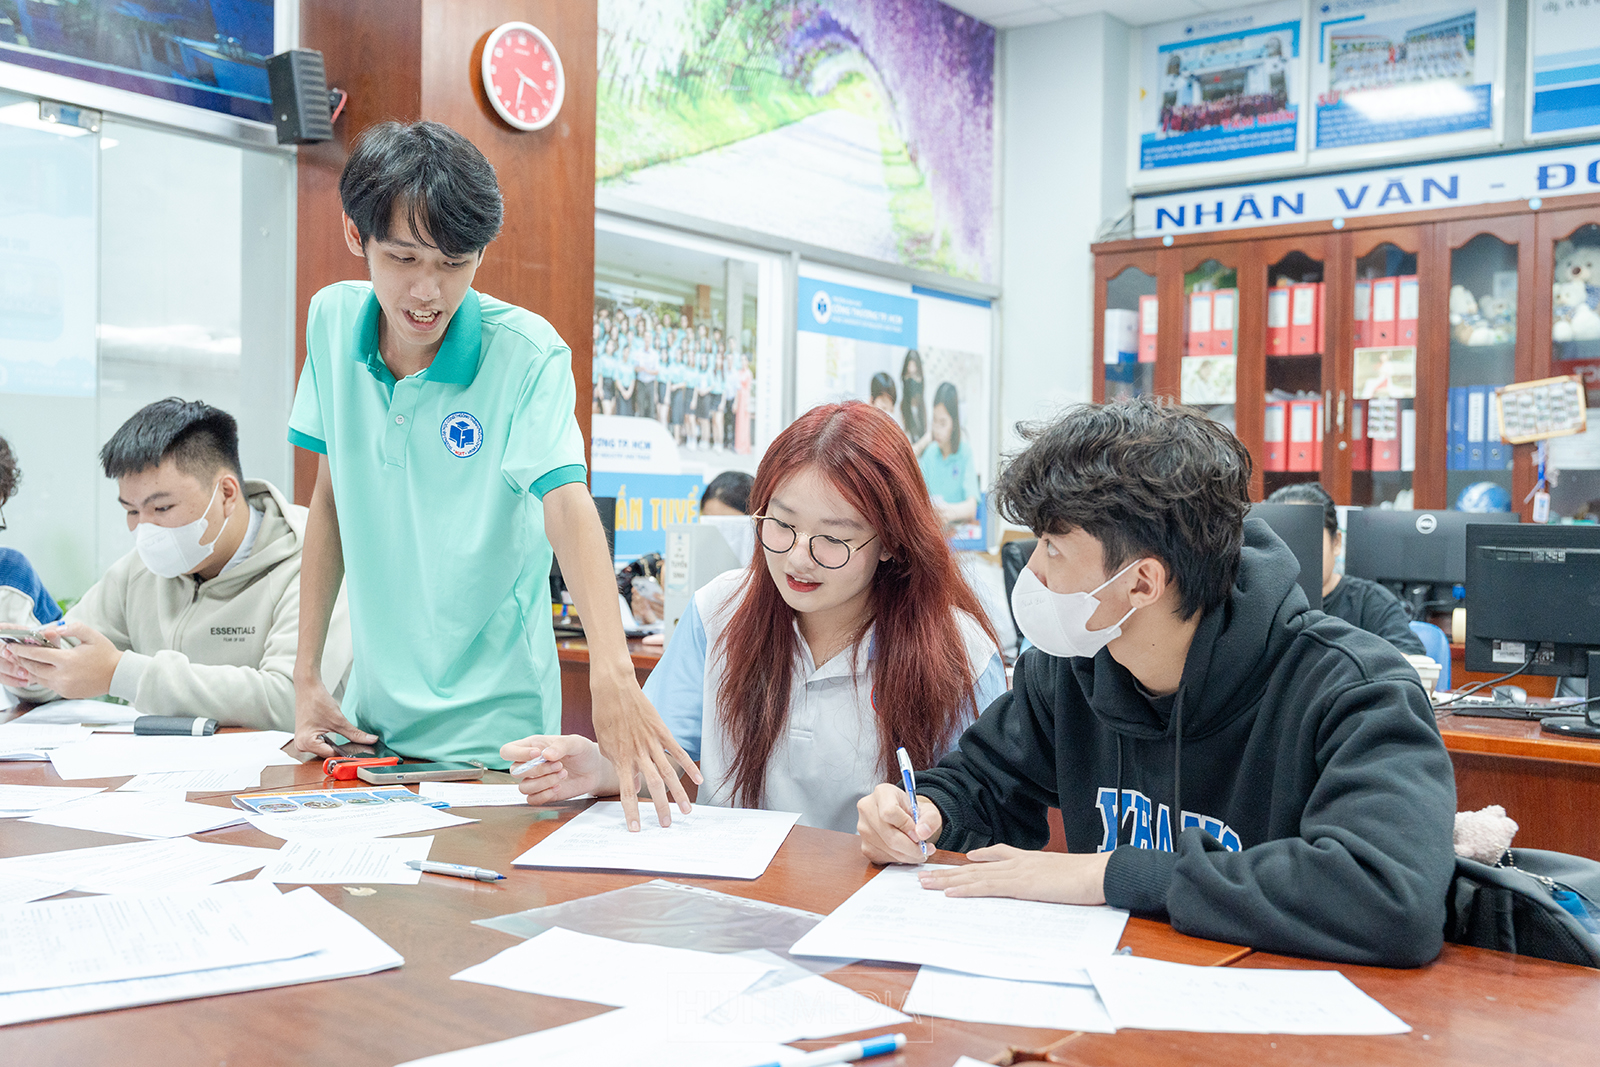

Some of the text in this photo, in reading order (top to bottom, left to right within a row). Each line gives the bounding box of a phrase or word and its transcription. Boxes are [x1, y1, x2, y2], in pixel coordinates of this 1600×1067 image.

[1156, 192, 1304, 229] NHÂN
[1335, 175, 1459, 210] VĂN
[210, 626, 256, 635] ESSENTIALS
